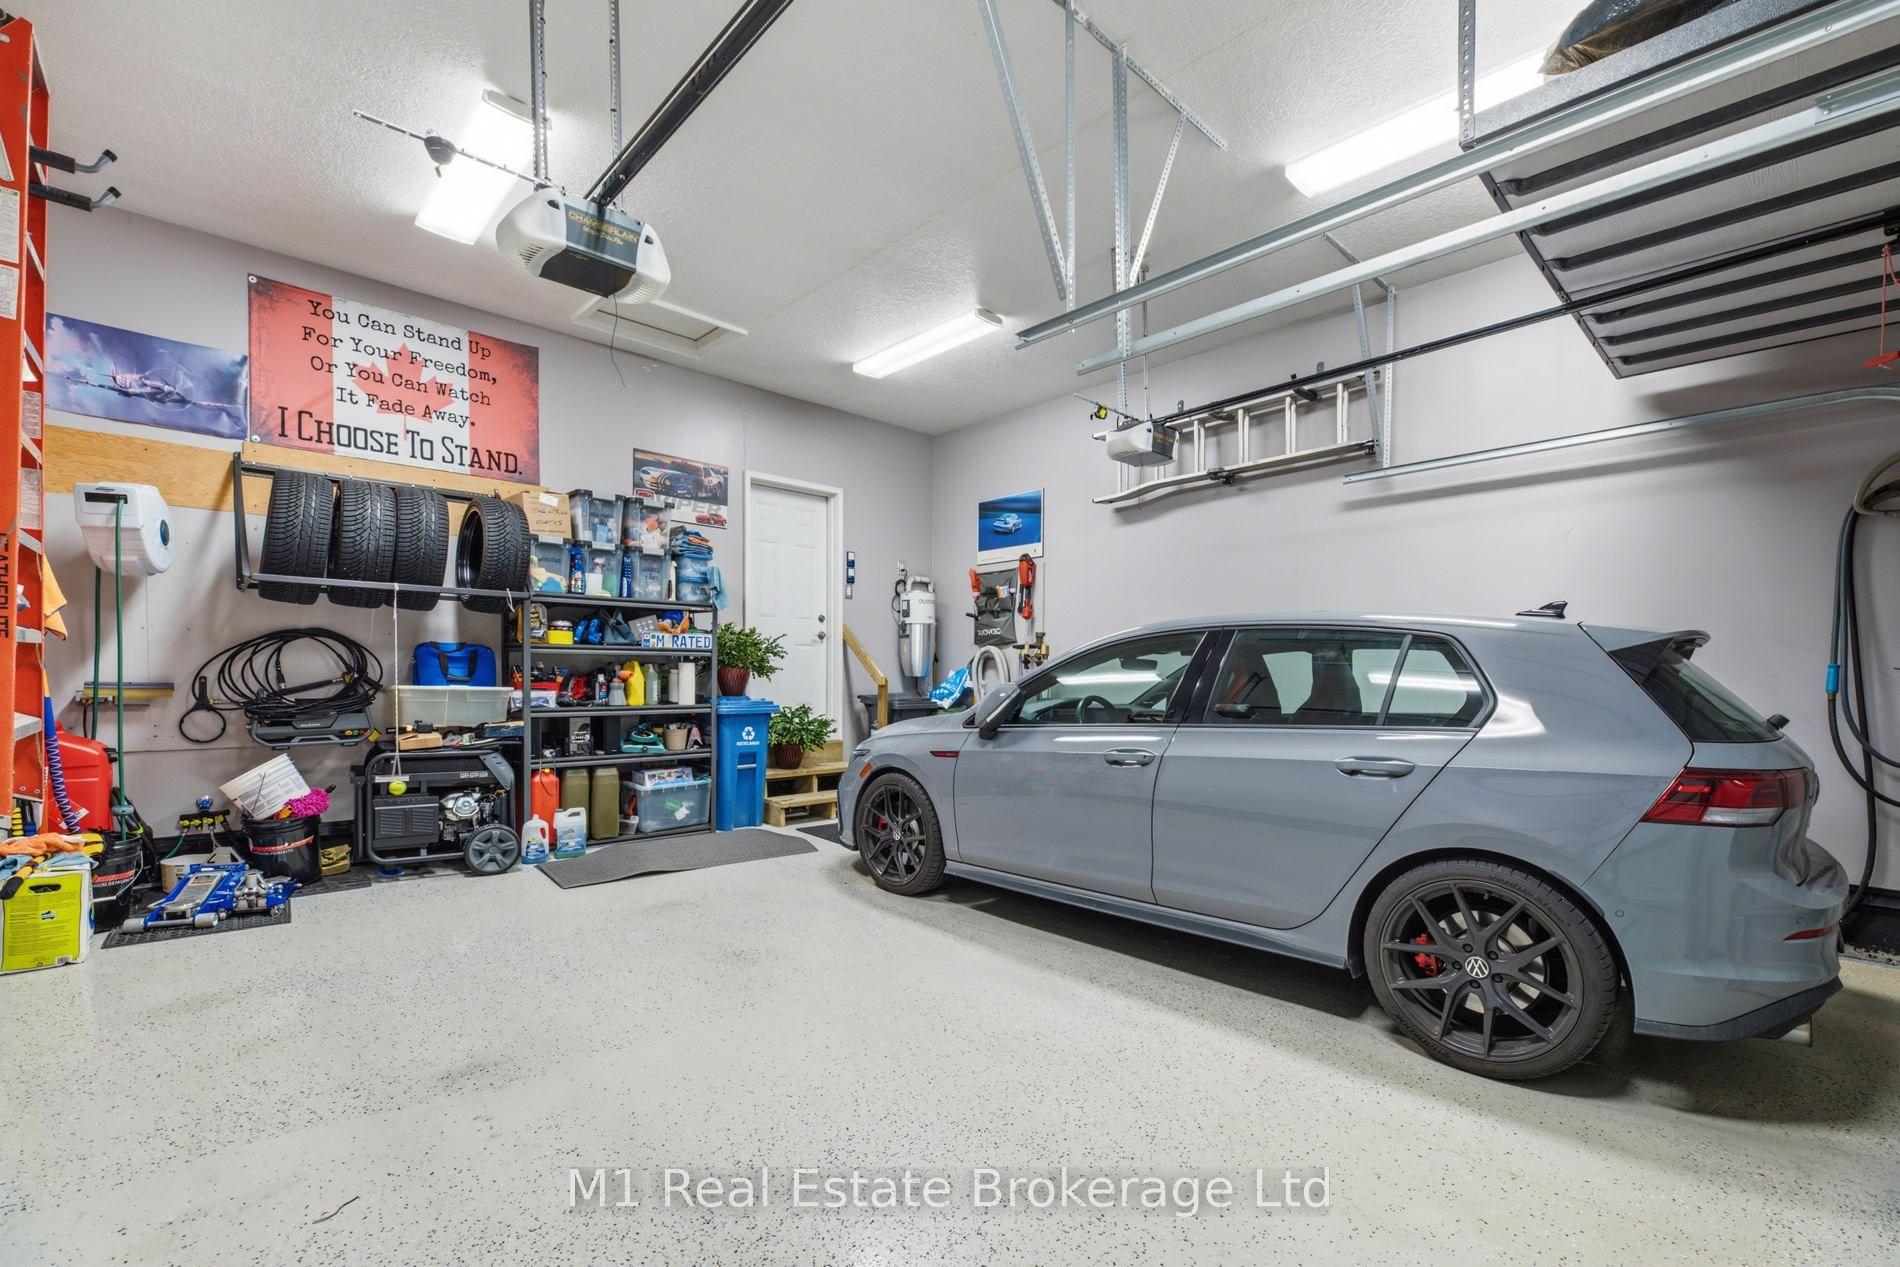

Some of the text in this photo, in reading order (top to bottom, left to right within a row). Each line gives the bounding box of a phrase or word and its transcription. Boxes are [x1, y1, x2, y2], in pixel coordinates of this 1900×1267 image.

[308, 299, 492, 360] You Can Stand Up
[301, 325, 497, 386] For Your Freedom,
[310, 355, 492, 407] Or You Can Watch
[278, 406, 289, 438] I
[336, 386, 476, 428] It Fade Away.
[672, 634, 711, 648] RATED
